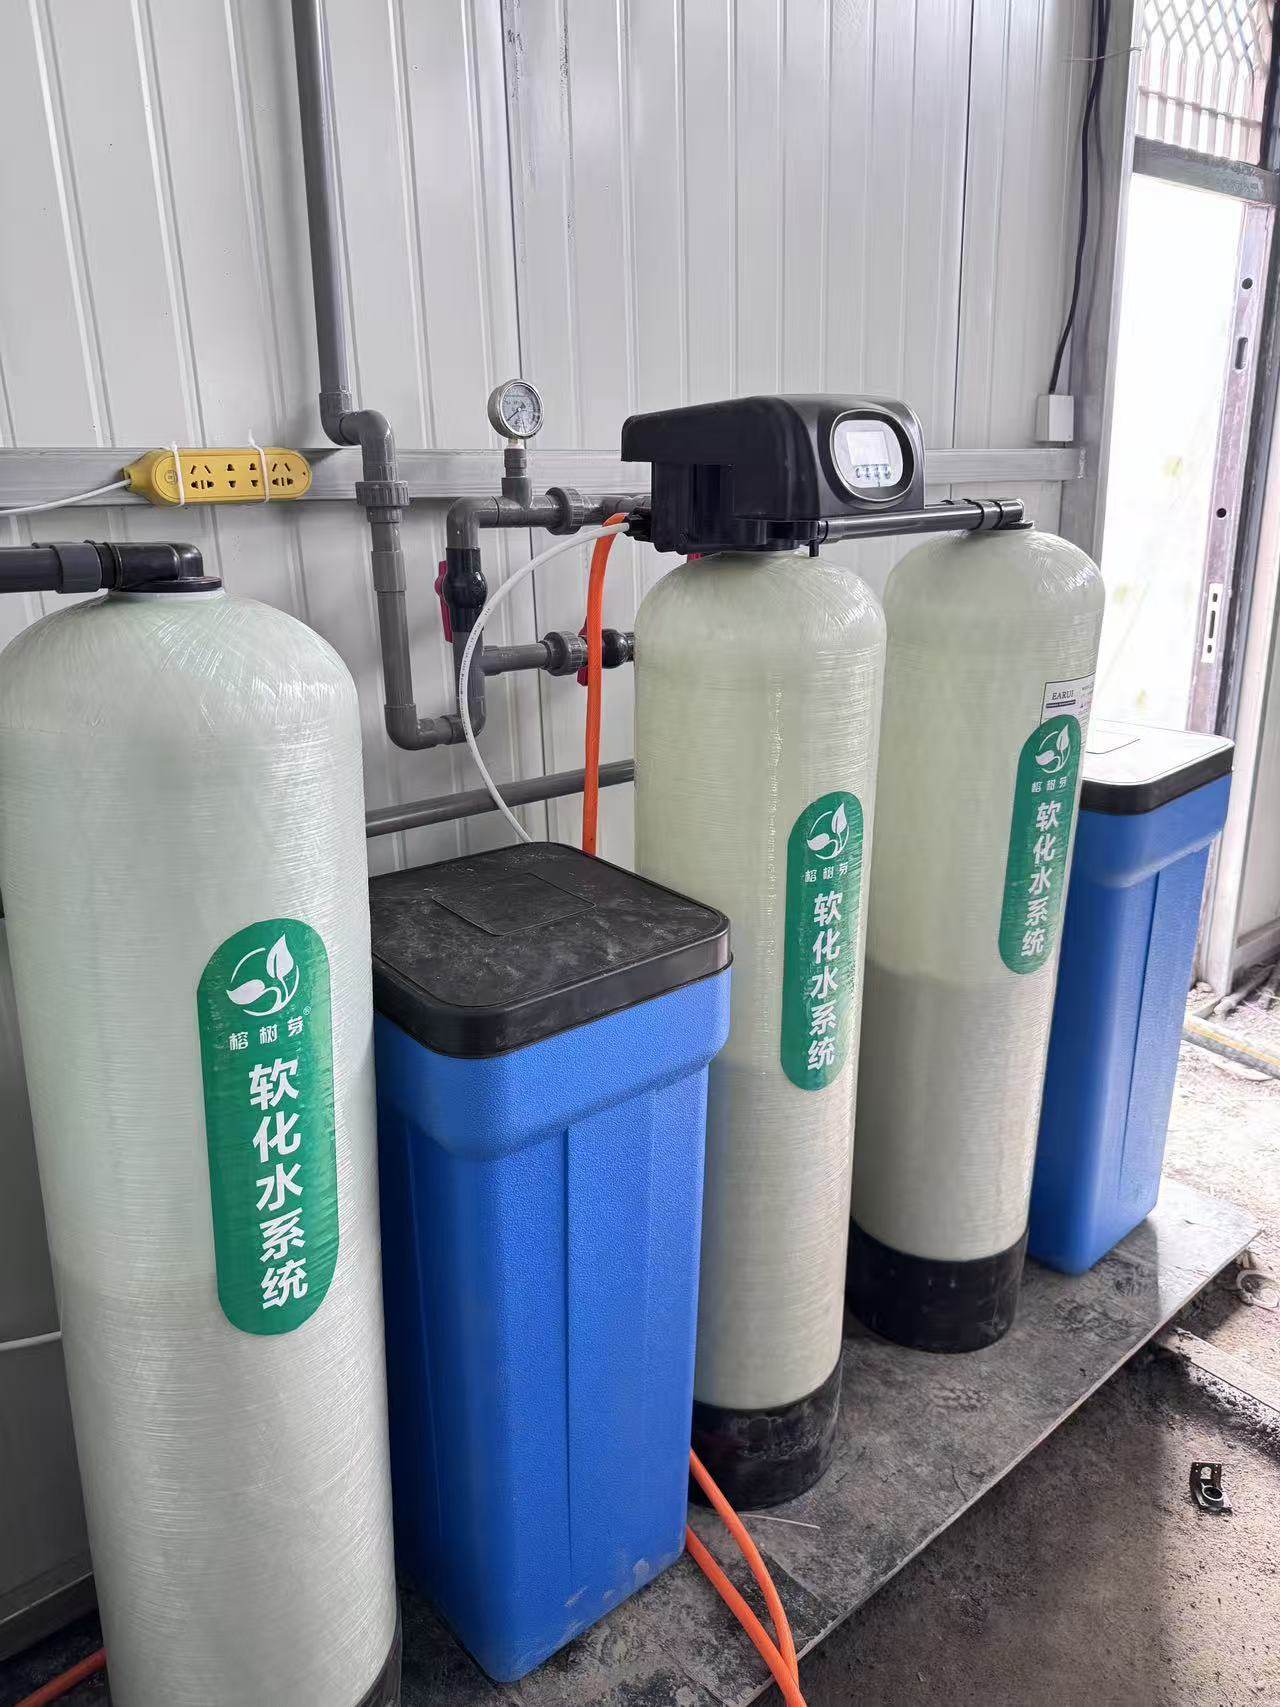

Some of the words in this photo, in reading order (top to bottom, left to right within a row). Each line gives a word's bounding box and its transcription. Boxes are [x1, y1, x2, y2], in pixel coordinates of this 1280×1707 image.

[1021, 800, 1061, 957] 软化水系统
[229, 1015, 304, 1051] 榕树芽
[807, 890, 843, 1071] 软化水系统
[249, 1057, 309, 1310] 软化水系统
